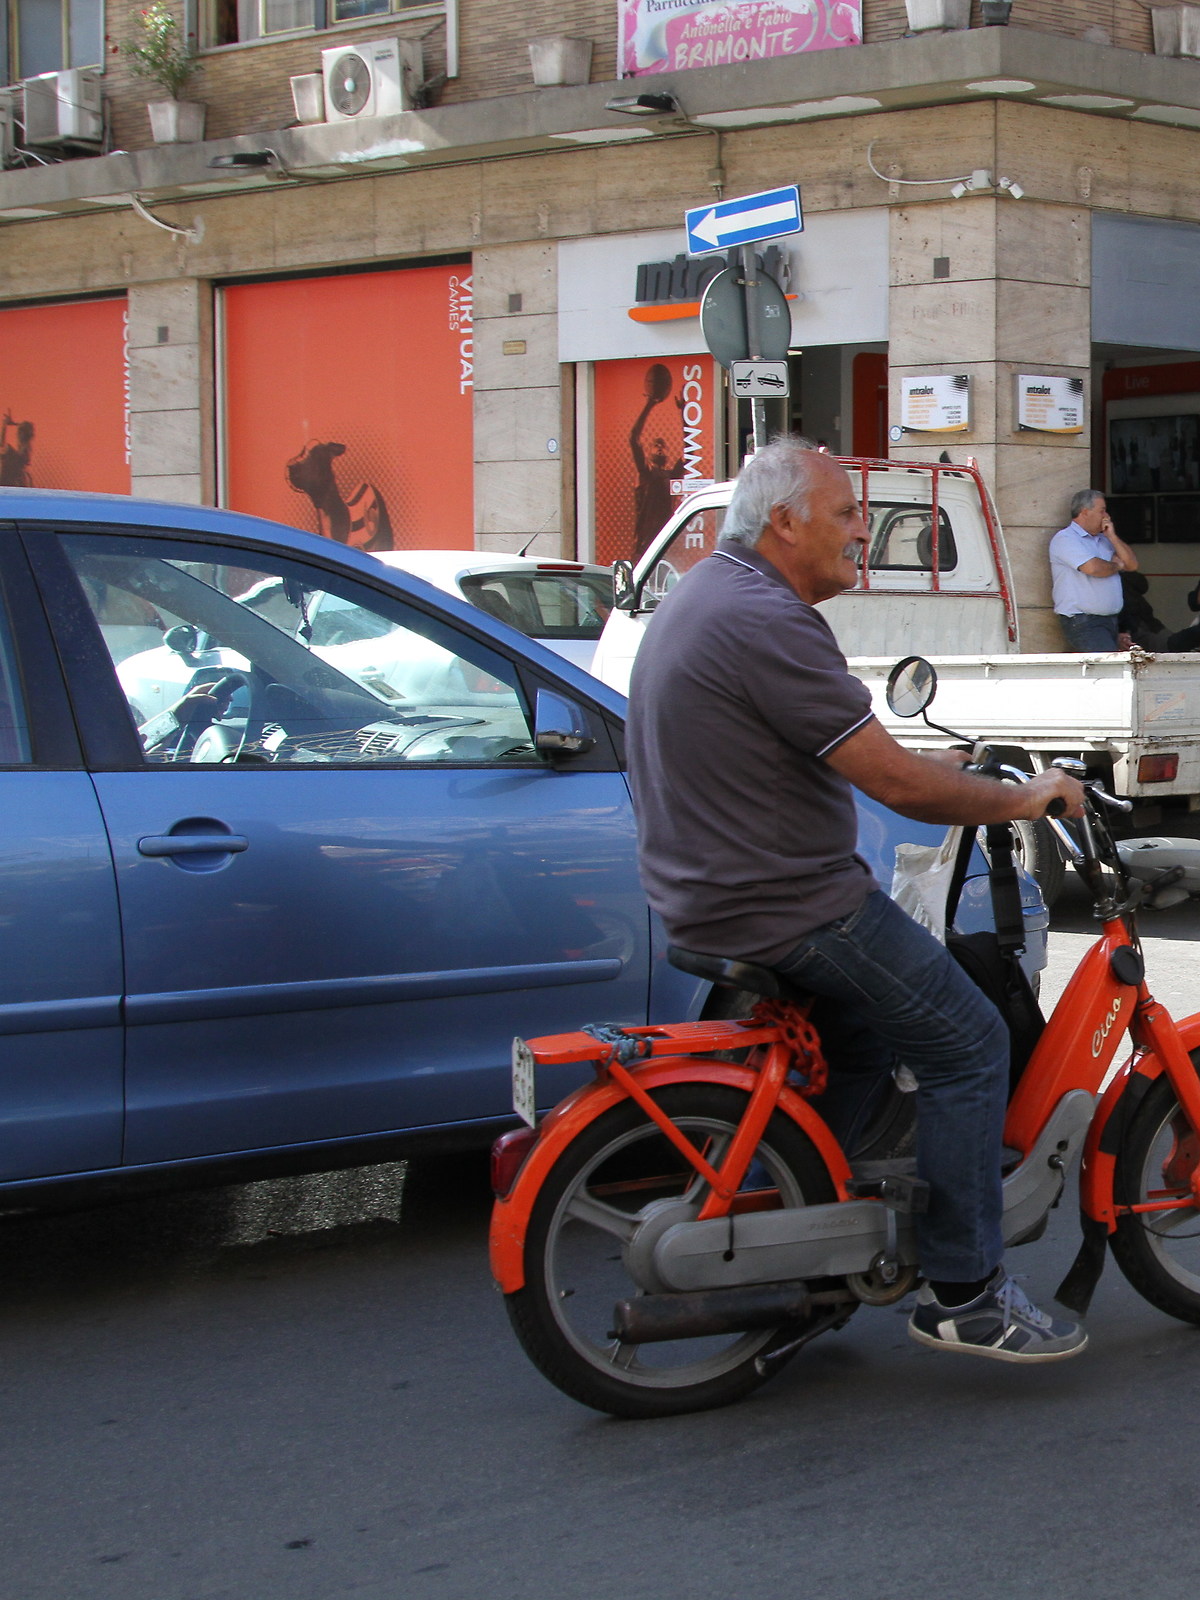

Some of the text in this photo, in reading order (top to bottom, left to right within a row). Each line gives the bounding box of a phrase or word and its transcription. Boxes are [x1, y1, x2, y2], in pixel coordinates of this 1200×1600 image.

[674, 27, 799, 69] BRAMONTE
[680, 10, 792, 39] Antonella e Fabio
[449, 275, 459, 331] GAMES
[1092, 997, 1122, 1058] Ciao
